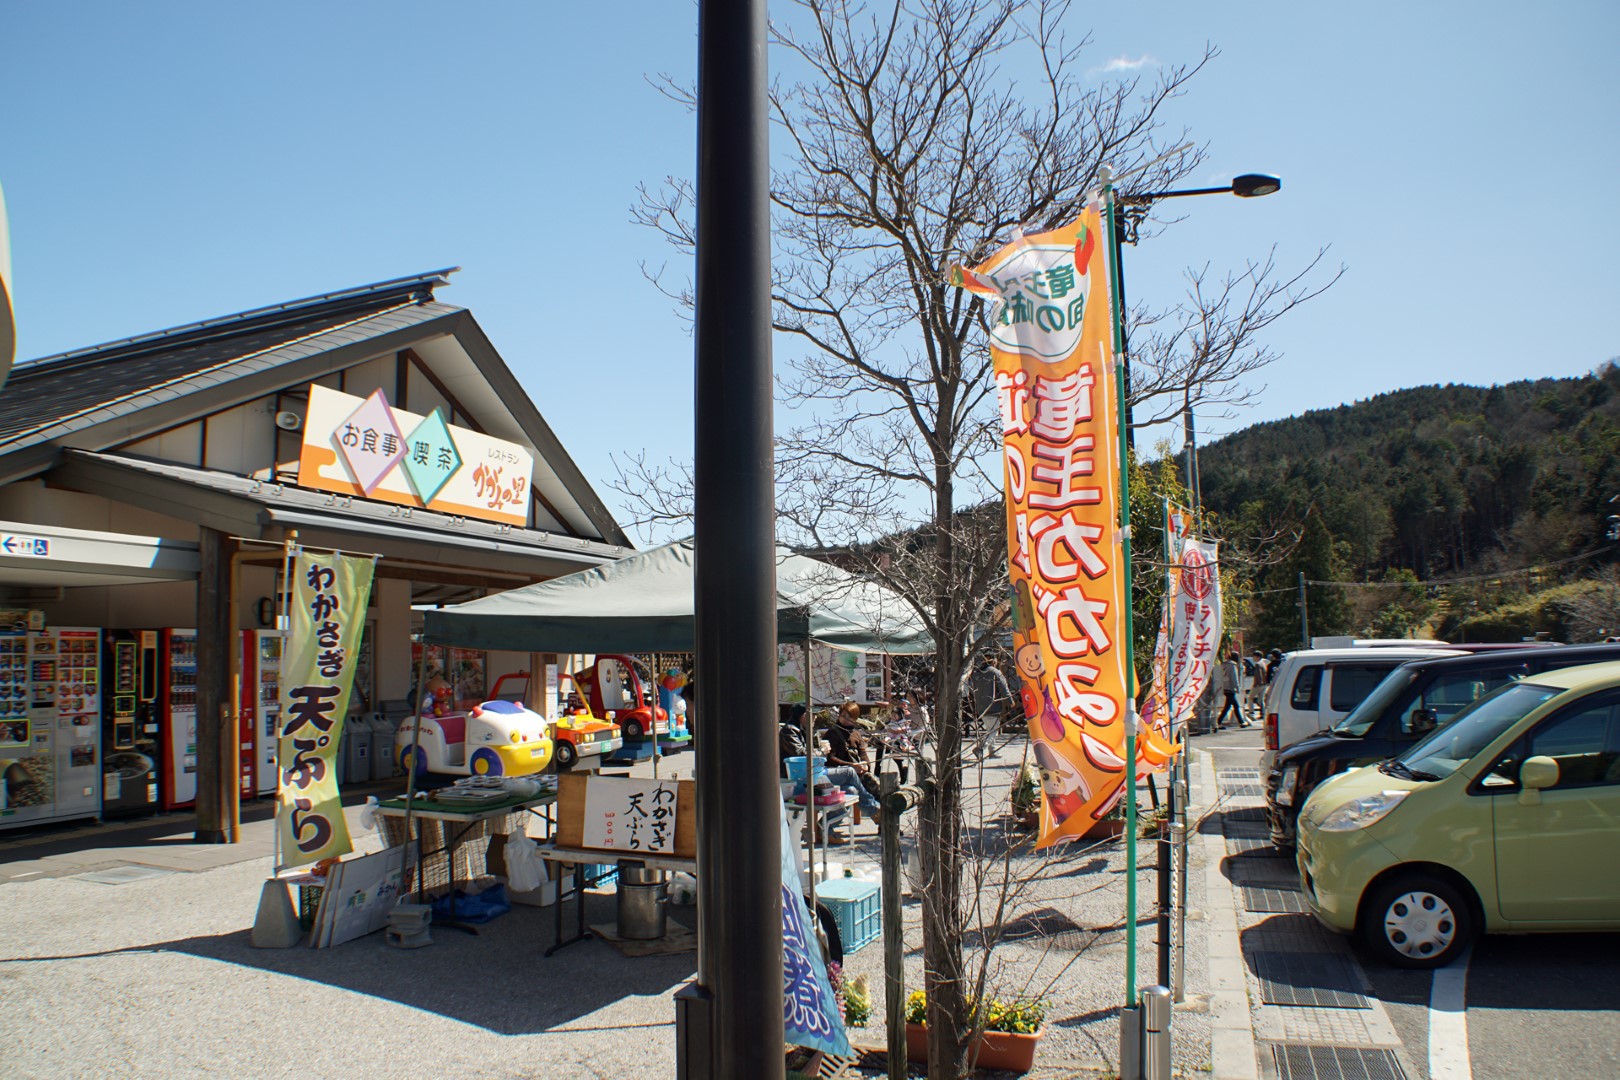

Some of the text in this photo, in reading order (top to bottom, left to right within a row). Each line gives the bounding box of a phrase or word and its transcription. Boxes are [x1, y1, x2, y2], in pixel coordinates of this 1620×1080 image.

[342, 422, 399, 457] お食事
[413, 440, 452, 472] 喫茶
[488, 448, 520, 465] レストラン
[472, 462, 526, 511] かがみの里
[647, 782, 675, 851] わかさぎ
